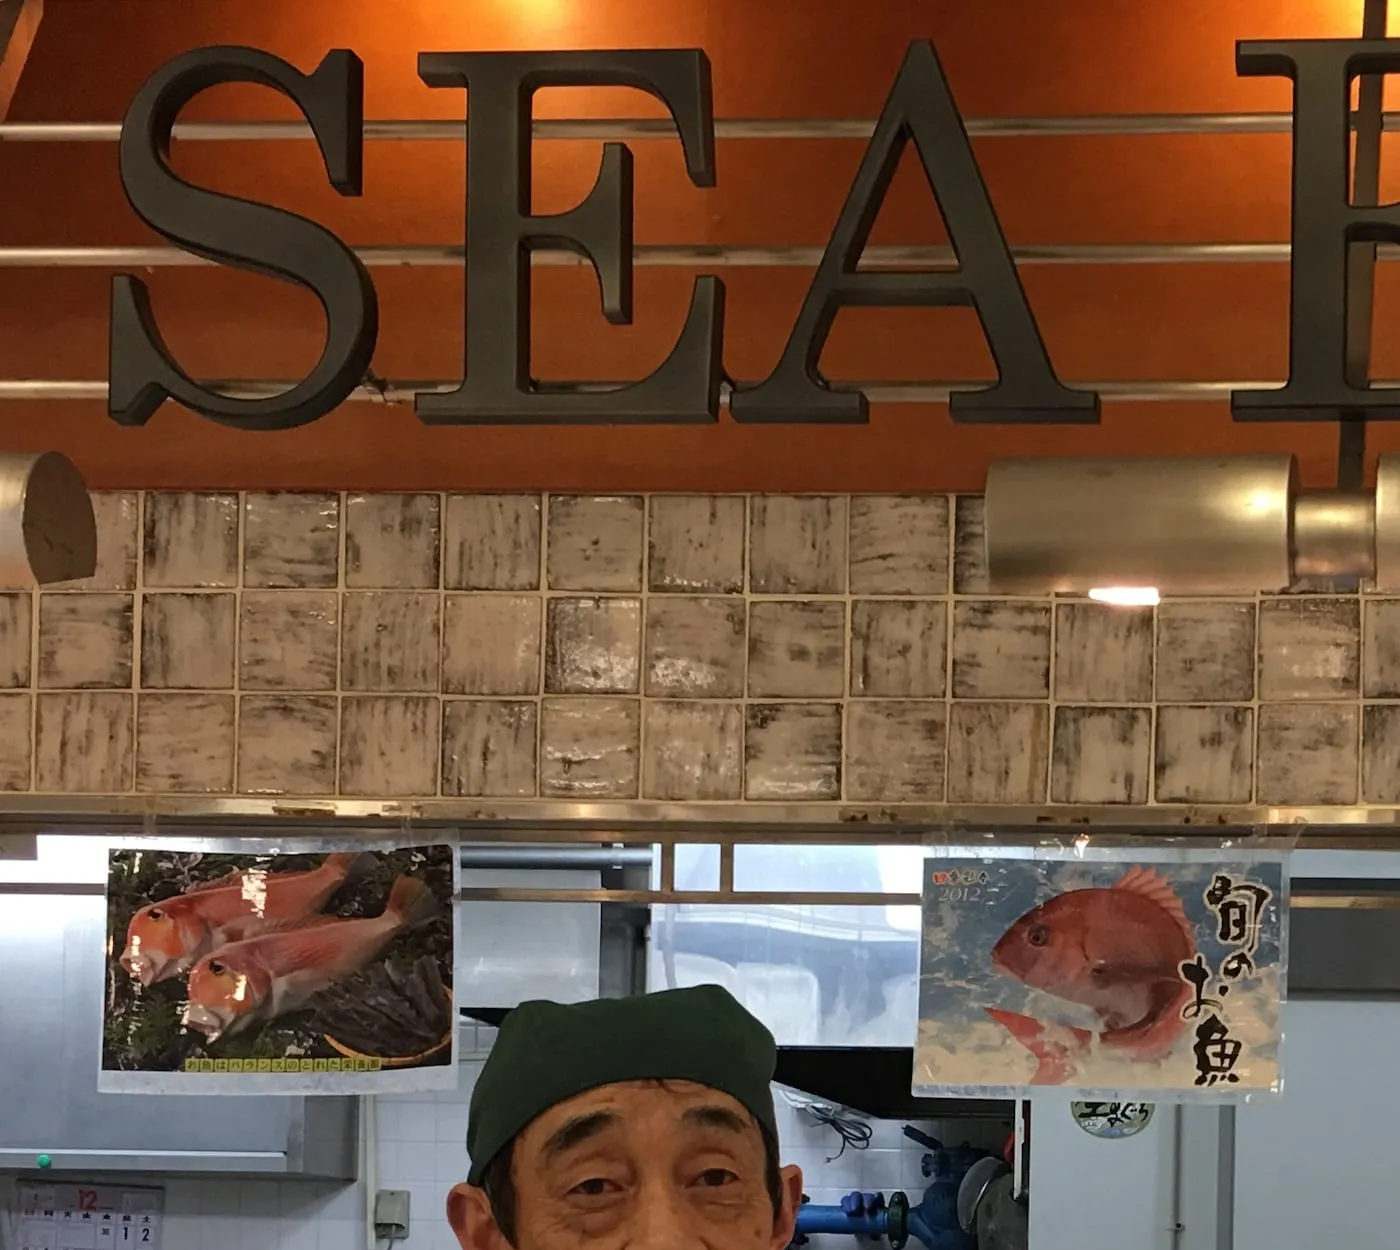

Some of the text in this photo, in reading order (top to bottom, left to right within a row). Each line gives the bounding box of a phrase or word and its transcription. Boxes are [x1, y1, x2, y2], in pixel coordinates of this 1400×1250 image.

[109, 39, 1100, 430] SEA
[939, 888, 981, 901] 2012
[78, 1190, 98, 1211] 12
[123, 1227, 128, 1240] 1
[142, 1229, 150, 1242] 2
